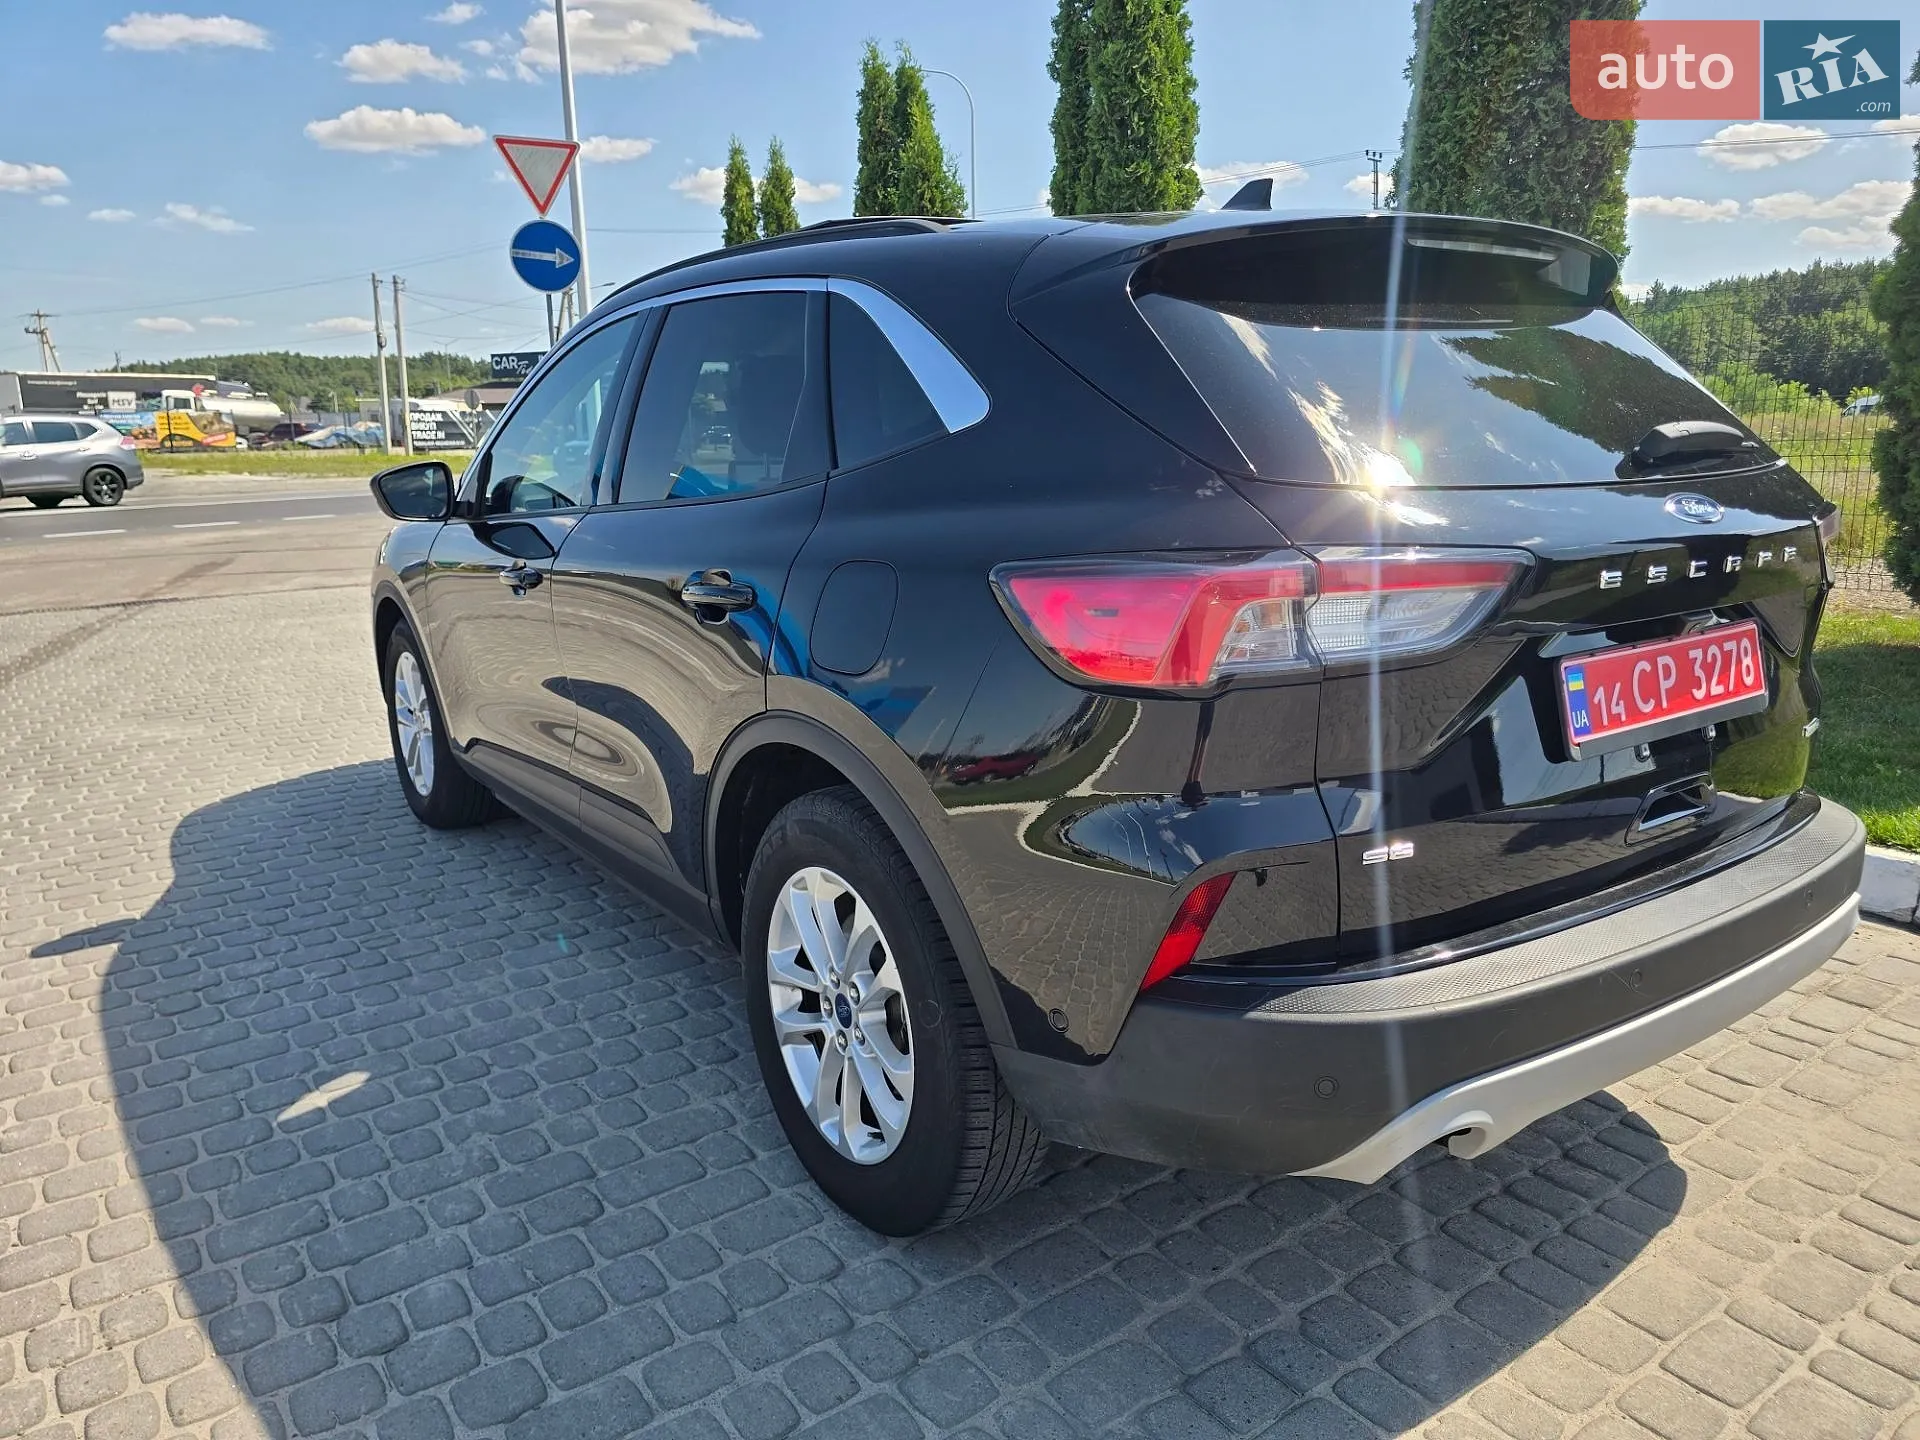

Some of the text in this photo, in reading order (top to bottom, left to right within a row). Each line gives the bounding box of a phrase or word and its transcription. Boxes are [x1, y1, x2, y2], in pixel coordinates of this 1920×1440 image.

[492, 356, 519, 370] CAR
[1600, 546, 1797, 589] ESCAPE
[1593, 682, 1627, 727] 14
[1689, 637, 1755, 701] 3278
[1572, 709, 1590, 728] UA
